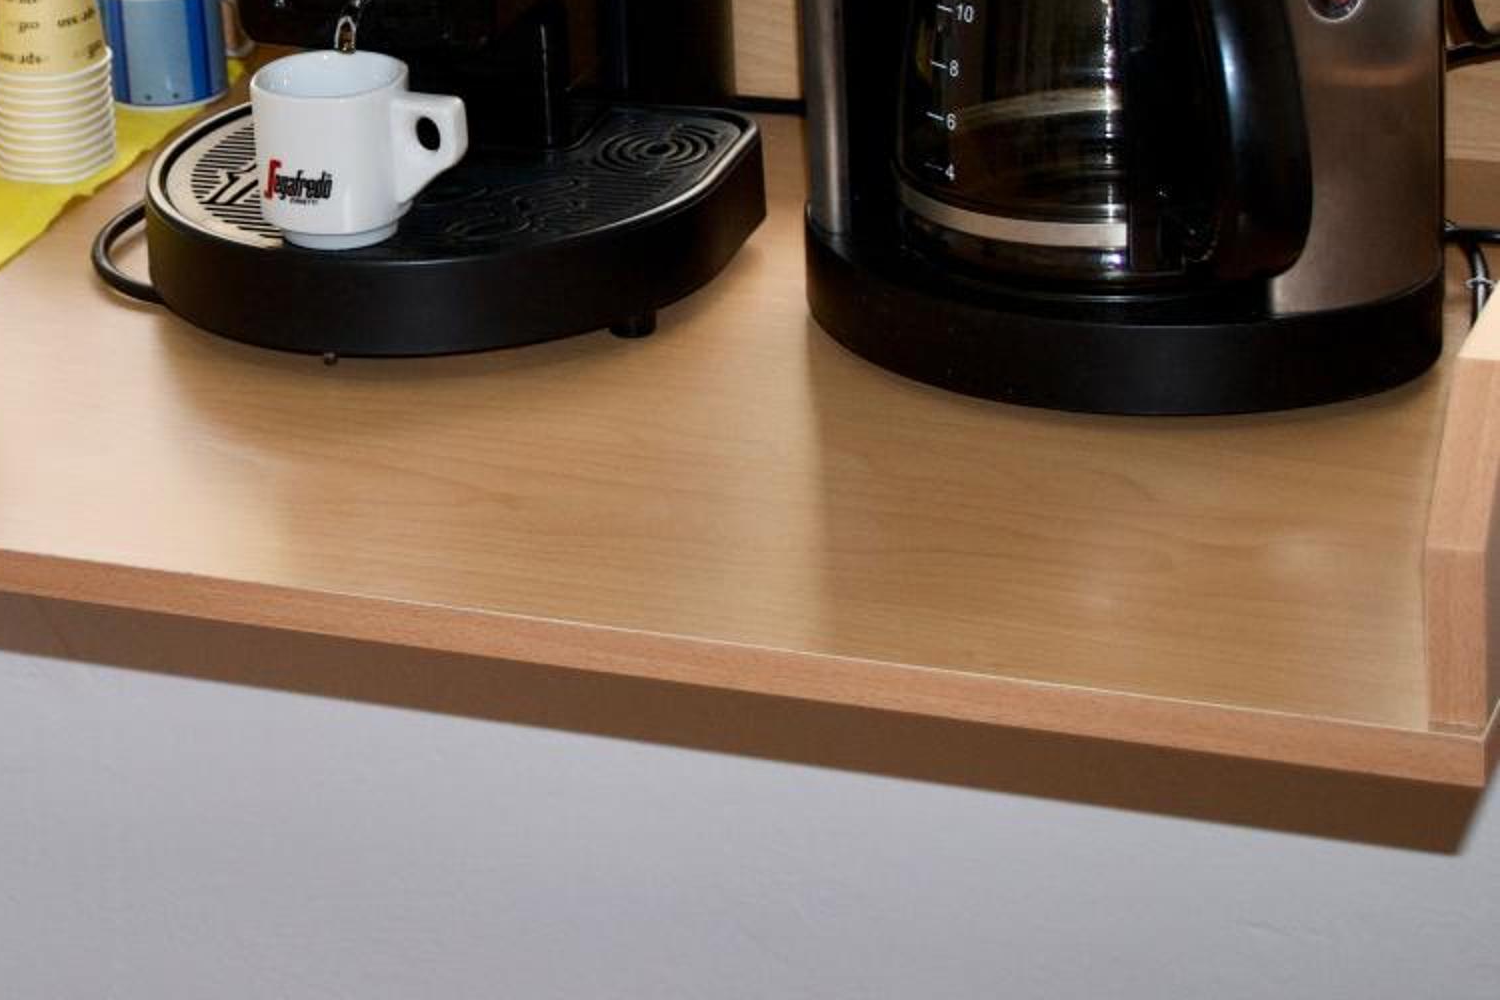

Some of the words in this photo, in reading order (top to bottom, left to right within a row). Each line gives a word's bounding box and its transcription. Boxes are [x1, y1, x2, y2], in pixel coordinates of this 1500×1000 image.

[956, 4, 974, 23] 10
[949, 59, 959, 77] 8
[946, 113, 956, 131] 6
[944, 163, 955, 181] 4
